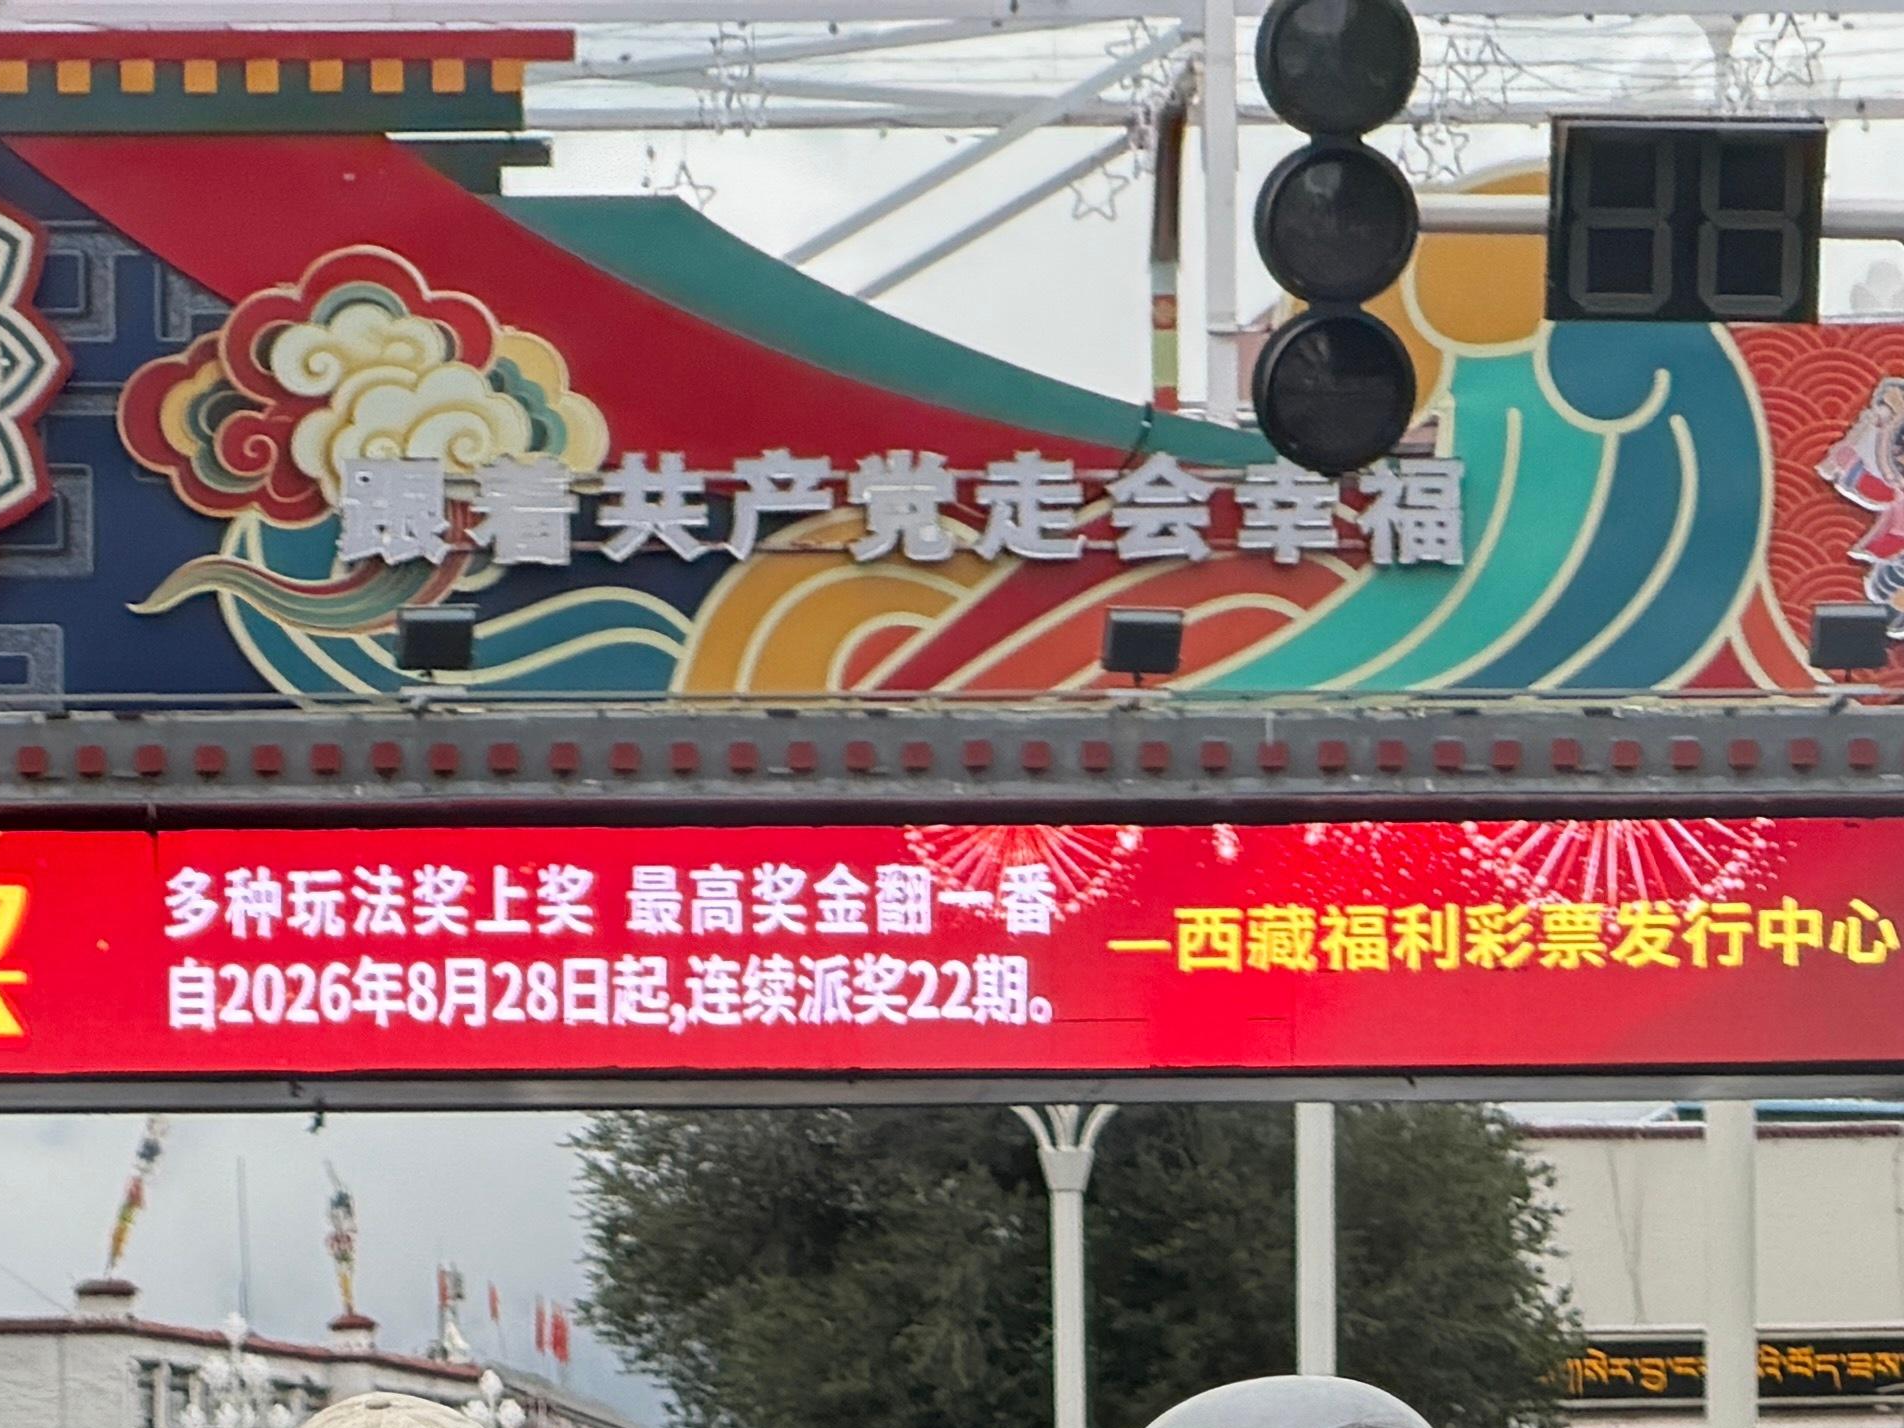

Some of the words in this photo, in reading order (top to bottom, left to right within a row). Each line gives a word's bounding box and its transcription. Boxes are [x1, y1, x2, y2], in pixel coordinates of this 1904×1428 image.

[339, 448, 1466, 566] 跟着共产党走会幸福
[163, 864, 595, 938] 多种玩法奖上奖
[625, 864, 1057, 936] 最高奖金翻一番
